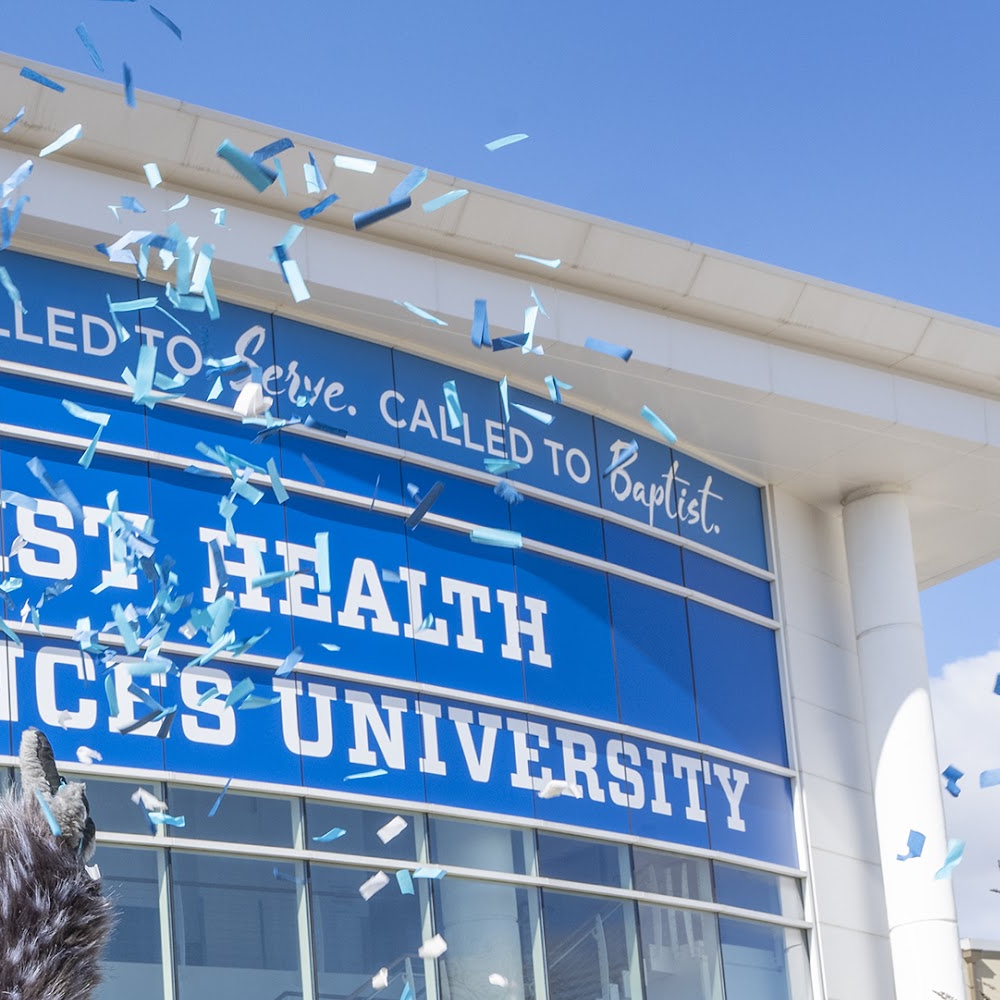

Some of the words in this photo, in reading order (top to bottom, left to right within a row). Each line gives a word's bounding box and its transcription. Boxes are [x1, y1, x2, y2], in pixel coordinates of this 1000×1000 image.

[134, 325, 202, 375] TO
[229, 325, 357, 416] Serve.
[379, 390, 533, 464] CALLED
[544, 438, 591, 484] TO
[607, 438, 723, 534] Baptist.
[199, 527, 553, 668] HEALTH
[272, 677, 750, 832] UNIVERSITY
